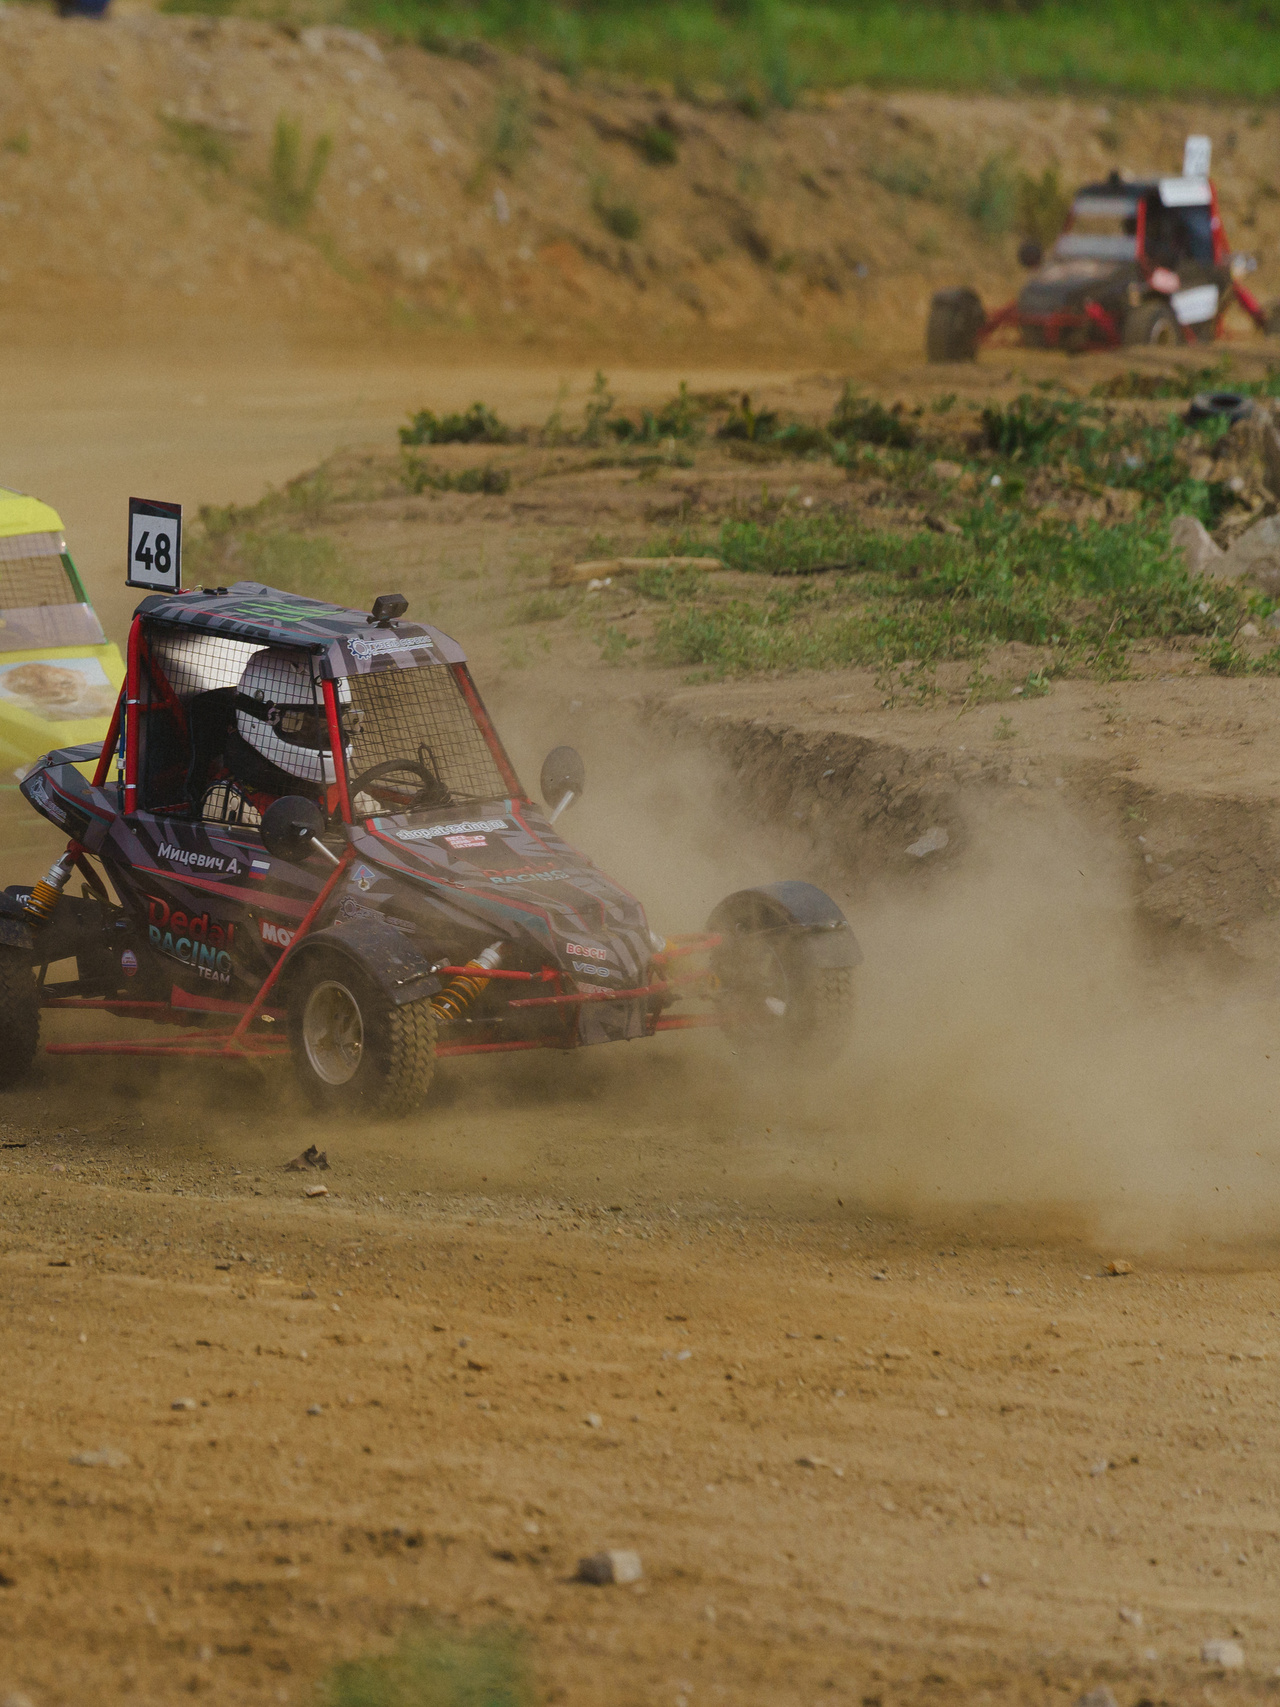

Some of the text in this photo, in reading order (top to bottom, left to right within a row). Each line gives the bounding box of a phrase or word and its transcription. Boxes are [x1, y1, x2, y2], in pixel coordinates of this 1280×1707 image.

[134, 531, 172, 574] 48
[157, 842, 242, 875] Мицевич А.
[489, 869, 566, 884] RACING
[145, 892, 235, 948] Dedal
[149, 924, 232, 974] RACING
[567, 943, 606, 960] BOSCH
[197, 965, 231, 985] TEAM
[572, 961, 610, 977] VDO
